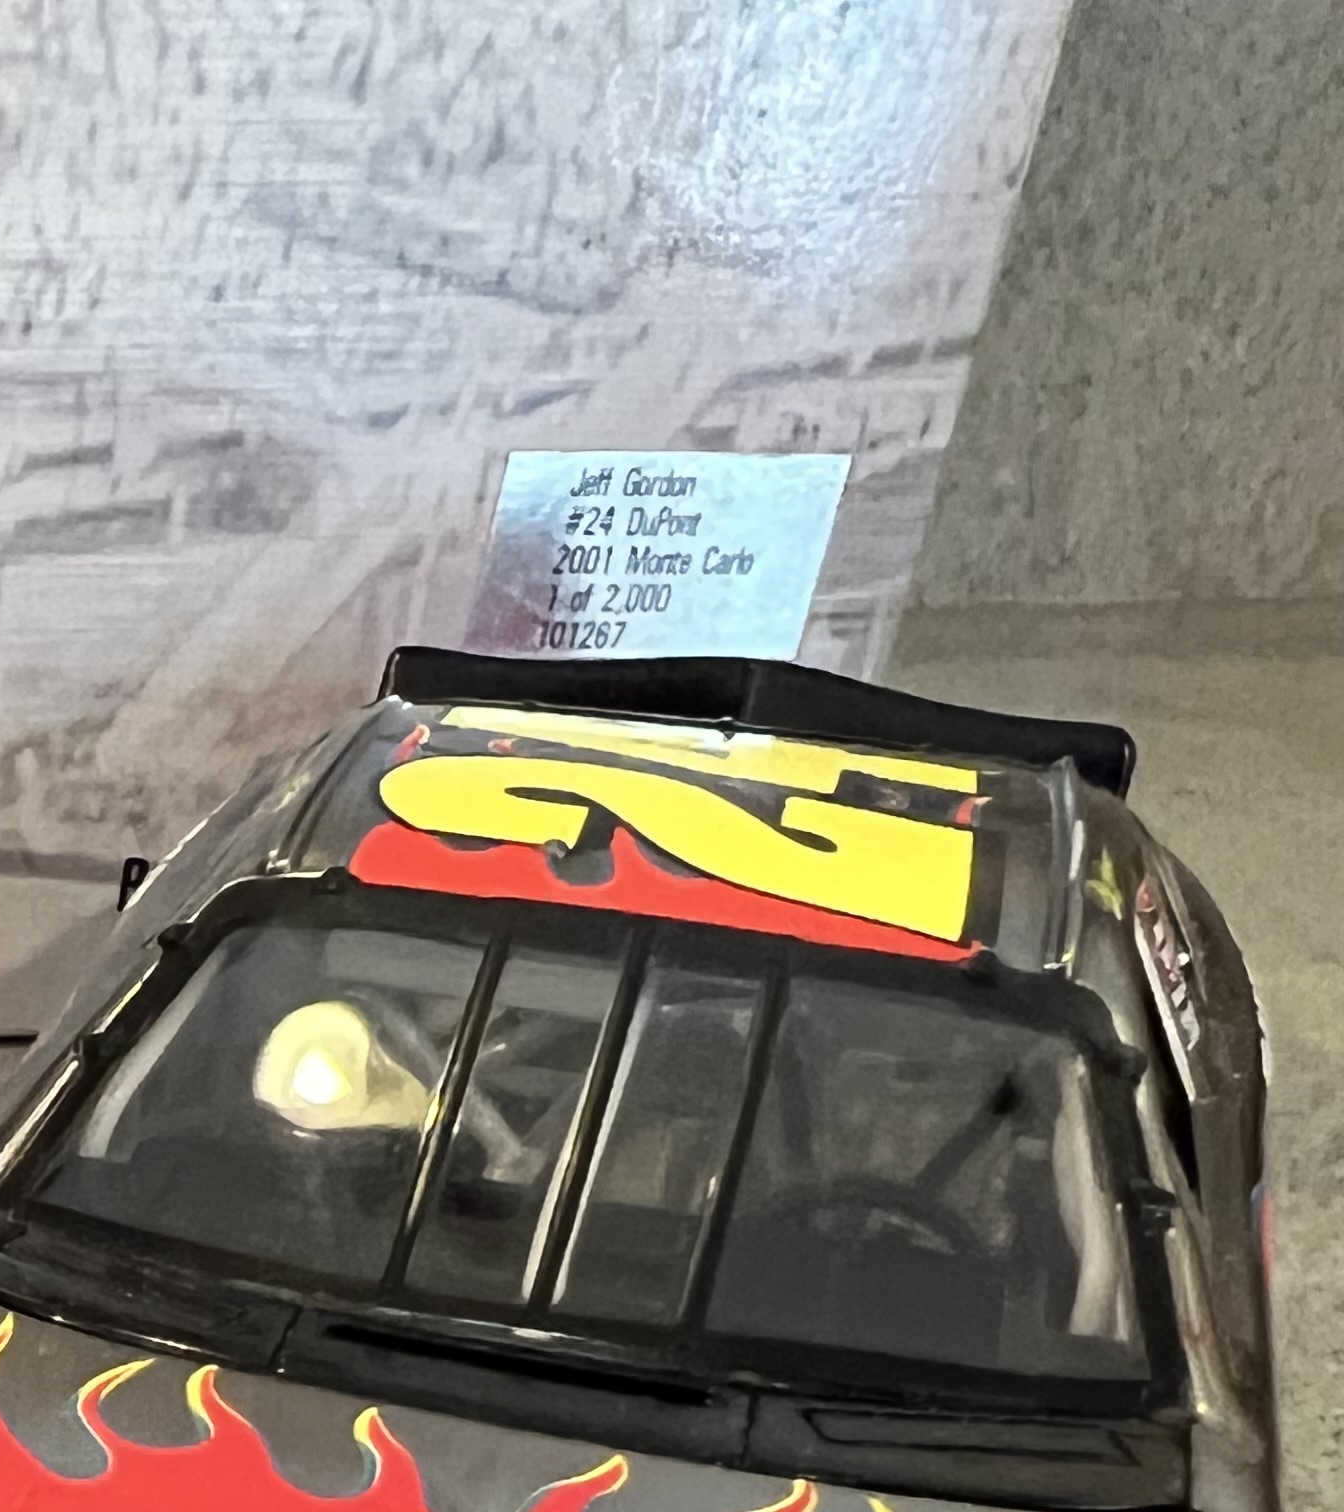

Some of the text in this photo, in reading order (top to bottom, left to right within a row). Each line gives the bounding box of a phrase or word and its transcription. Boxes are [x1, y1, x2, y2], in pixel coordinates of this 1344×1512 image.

[570, 467, 698, 498] Jeff Gordon
[565, 506, 703, 537] #24 DuPont
[552, 545, 755, 576] 2001 Monte Carlo
[548, 584, 672, 615] 1 of 2,000
[538, 621, 627, 650] 101267
